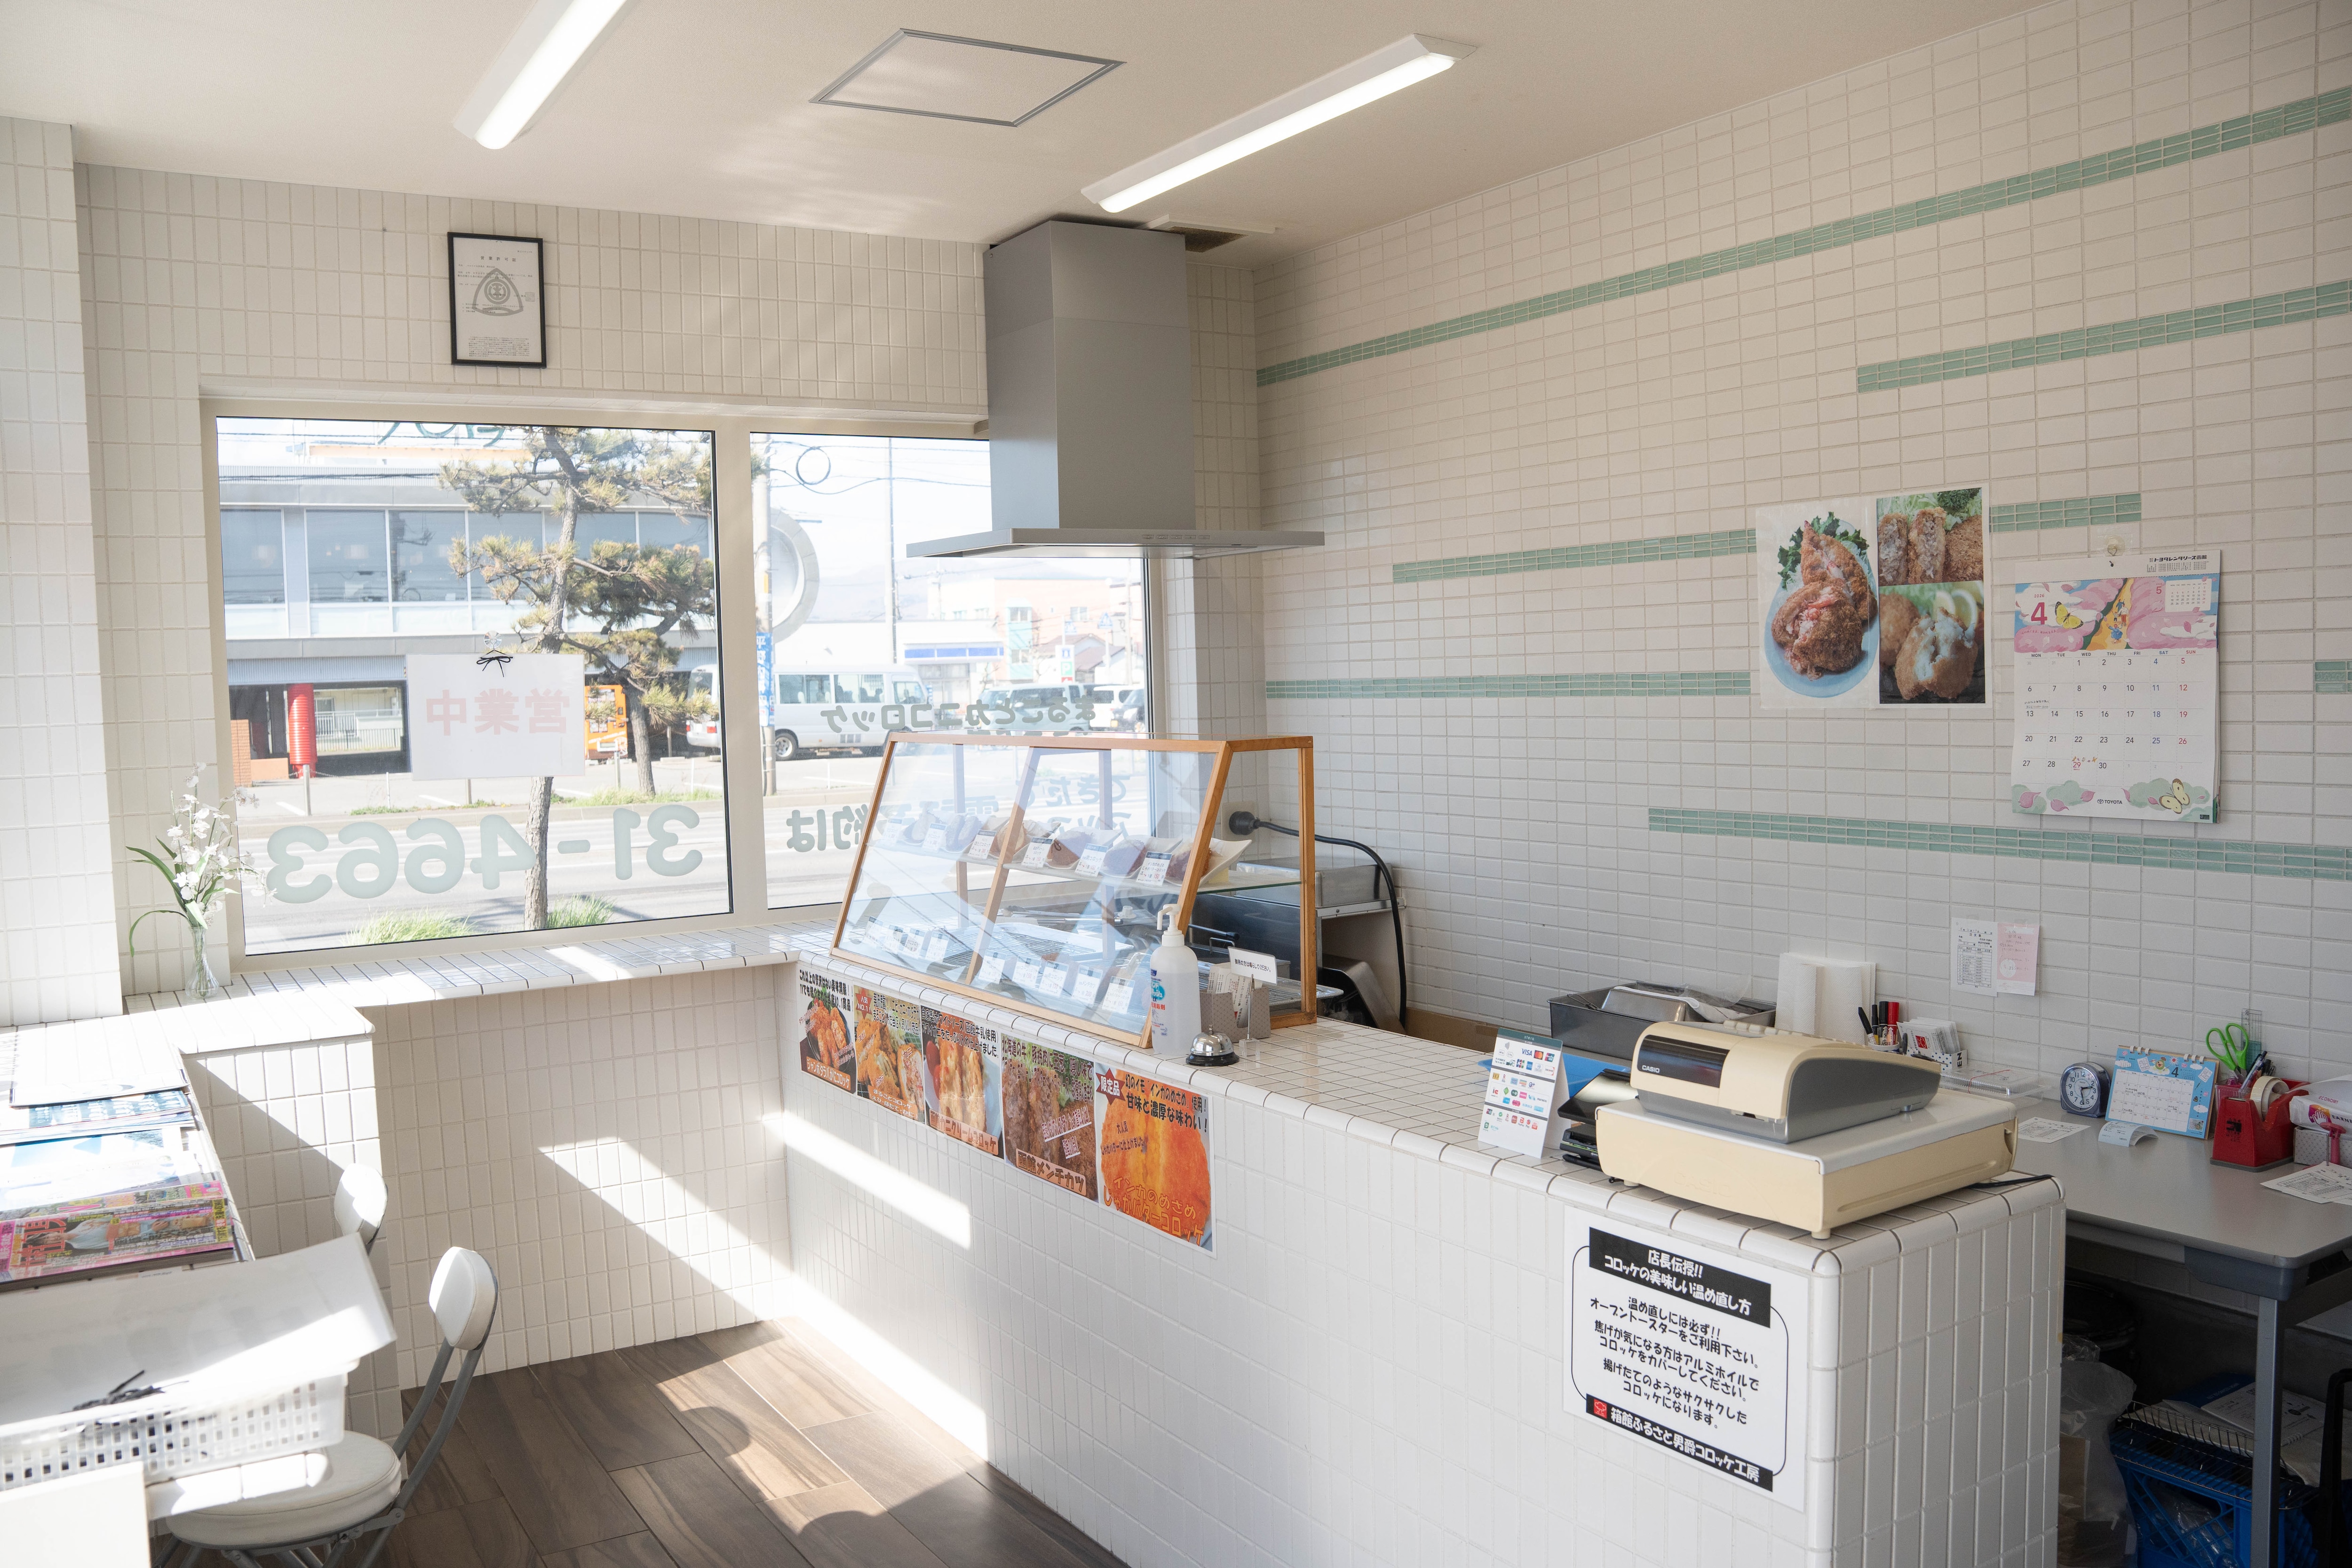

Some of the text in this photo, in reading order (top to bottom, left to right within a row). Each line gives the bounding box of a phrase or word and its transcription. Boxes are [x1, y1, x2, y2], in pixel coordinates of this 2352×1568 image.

[2031, 602, 2047, 625] 4
[1235, 959, 1271, 972] 御用の方は鳴らしてください。
[903, 1047, 913, 1059] カニ
[1516, 1059, 1526, 1068] JCB
[807, 1059, 850, 1088] ジャンボタラバがにコロッケ
[1642, 1065, 1660, 1073] CASIO
[2171, 1067, 2178, 1077] 4
[873, 1089, 912, 1109] まるごとコロッケ
[1101, 1076, 1120, 1096] 限定品
[2319, 1095, 2338, 1104] ECONOMY
[1117, 1121, 1128, 1134] 大人気
[2332, 1115, 2352, 1124] EARNE
[1018, 1151, 1084, 1192] 函館メンチカツ
[1113, 1177, 1196, 1219] インカのめざめ
[1104, 1185, 1203, 1246] じゃがバターコロッケ
[1605, 1255, 1751, 1315] コロッケの美味しい温め直し方
[1590, 1298, 1759, 1368] オーブントースターをご利用下さい。
[1594, 1320, 1759, 1391] 焦げが気になる方はアルミホイルで
[1600, 1336, 1746, 1401] コロッケをカバーしてください。
[1603, 1358, 1747, 1424] 揚げたてのようなサクサクした
[1623, 1381, 1718, 1428] コロッケになります。
[1611, 1407, 1759, 1482] 箱館ふるさと男爵コロッケ工房
